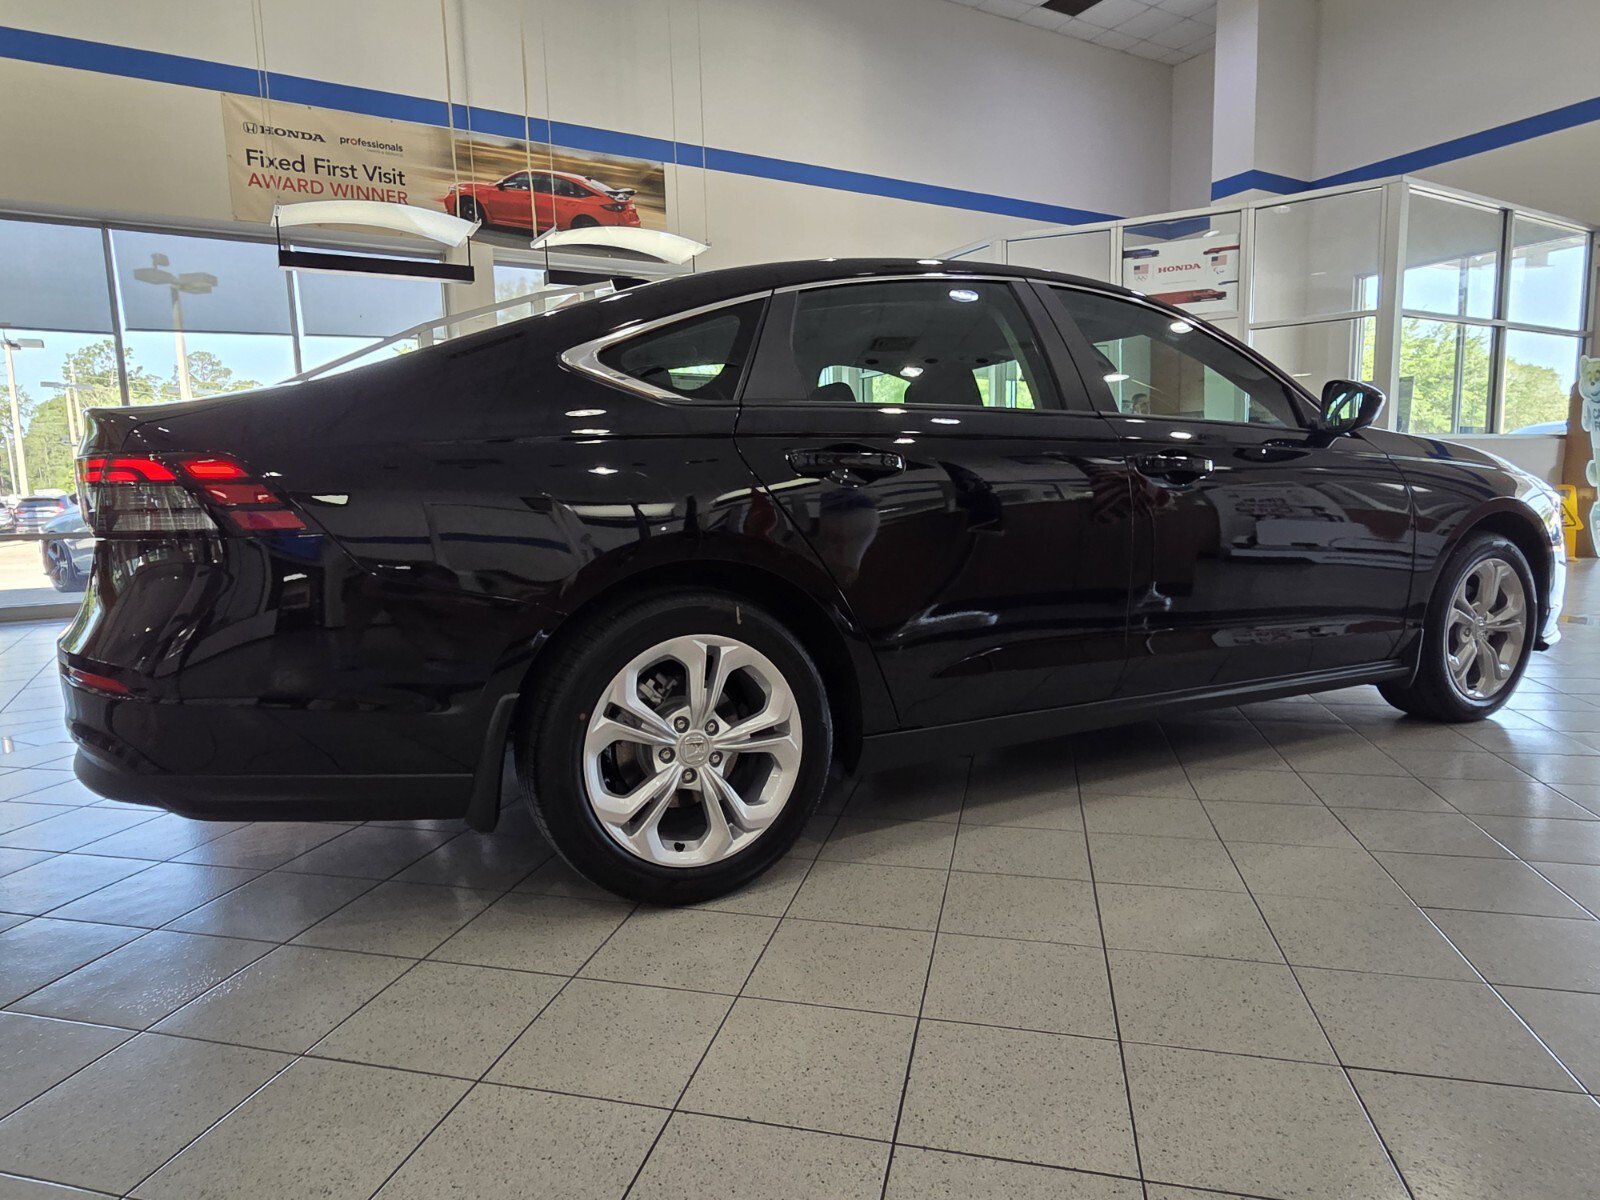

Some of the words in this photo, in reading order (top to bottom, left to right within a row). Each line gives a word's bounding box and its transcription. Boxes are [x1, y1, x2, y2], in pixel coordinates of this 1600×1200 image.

[259, 125, 327, 143] HONDA
[339, 136, 404, 152] professionals
[246, 148, 306, 173] Fixed
[314, 157, 358, 180] First
[362, 164, 406, 186] Visit
[247, 172, 325, 195] AWARD
[329, 181, 409, 205] WINNER
[1158, 263, 1202, 273] HONDA
